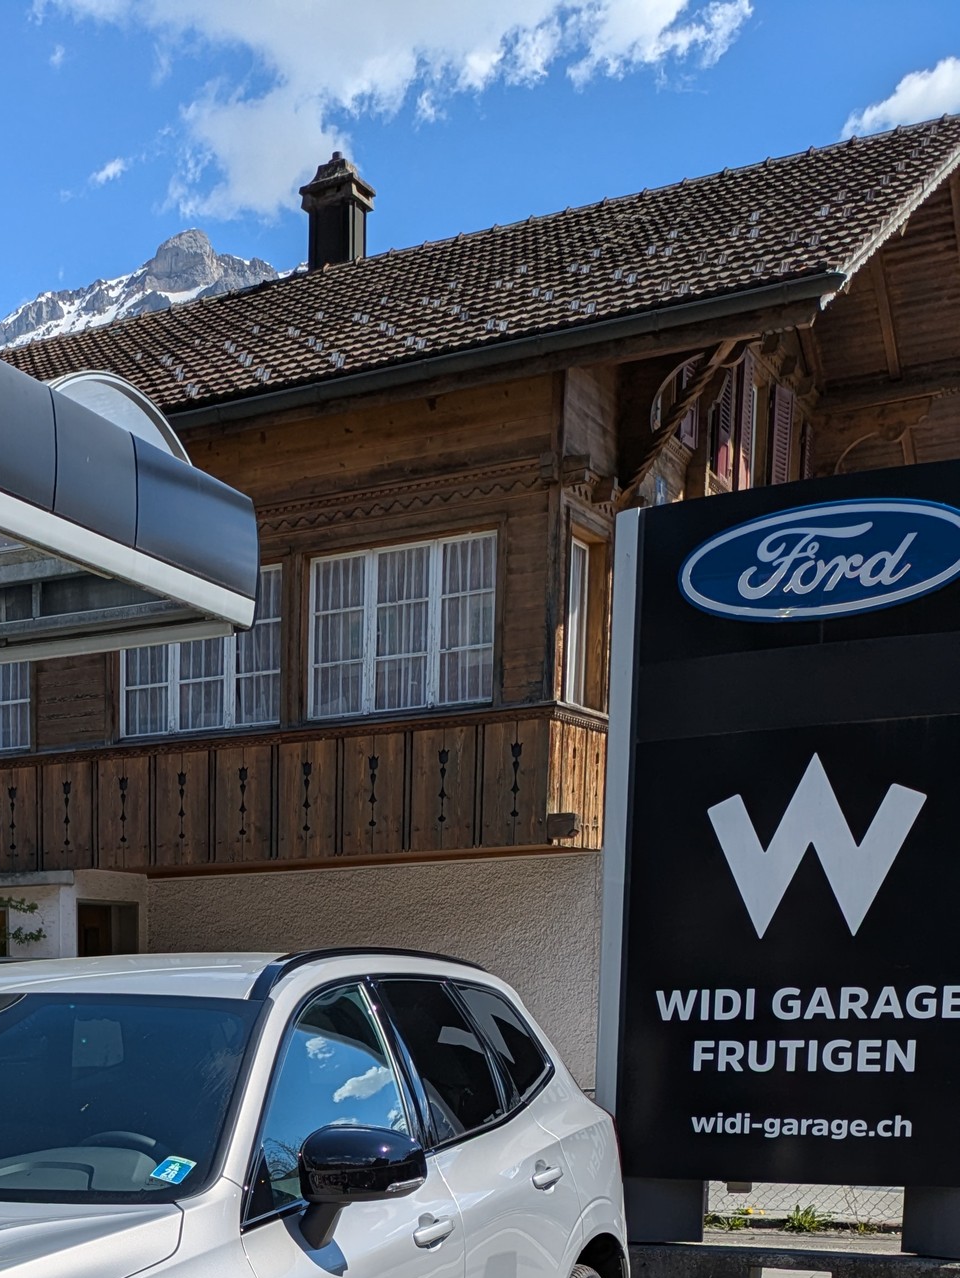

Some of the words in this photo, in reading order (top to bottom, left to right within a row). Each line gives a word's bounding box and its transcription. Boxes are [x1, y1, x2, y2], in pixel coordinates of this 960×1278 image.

[738, 521, 918, 600] Ford
[707, 752, 927, 939] W
[655, 988, 756, 1021] WIDI
[771, 985, 960, 1021] GARAGE
[692, 1039, 917, 1073] FRUTIGEN
[691, 1112, 913, 1140] widi-garage.ch
